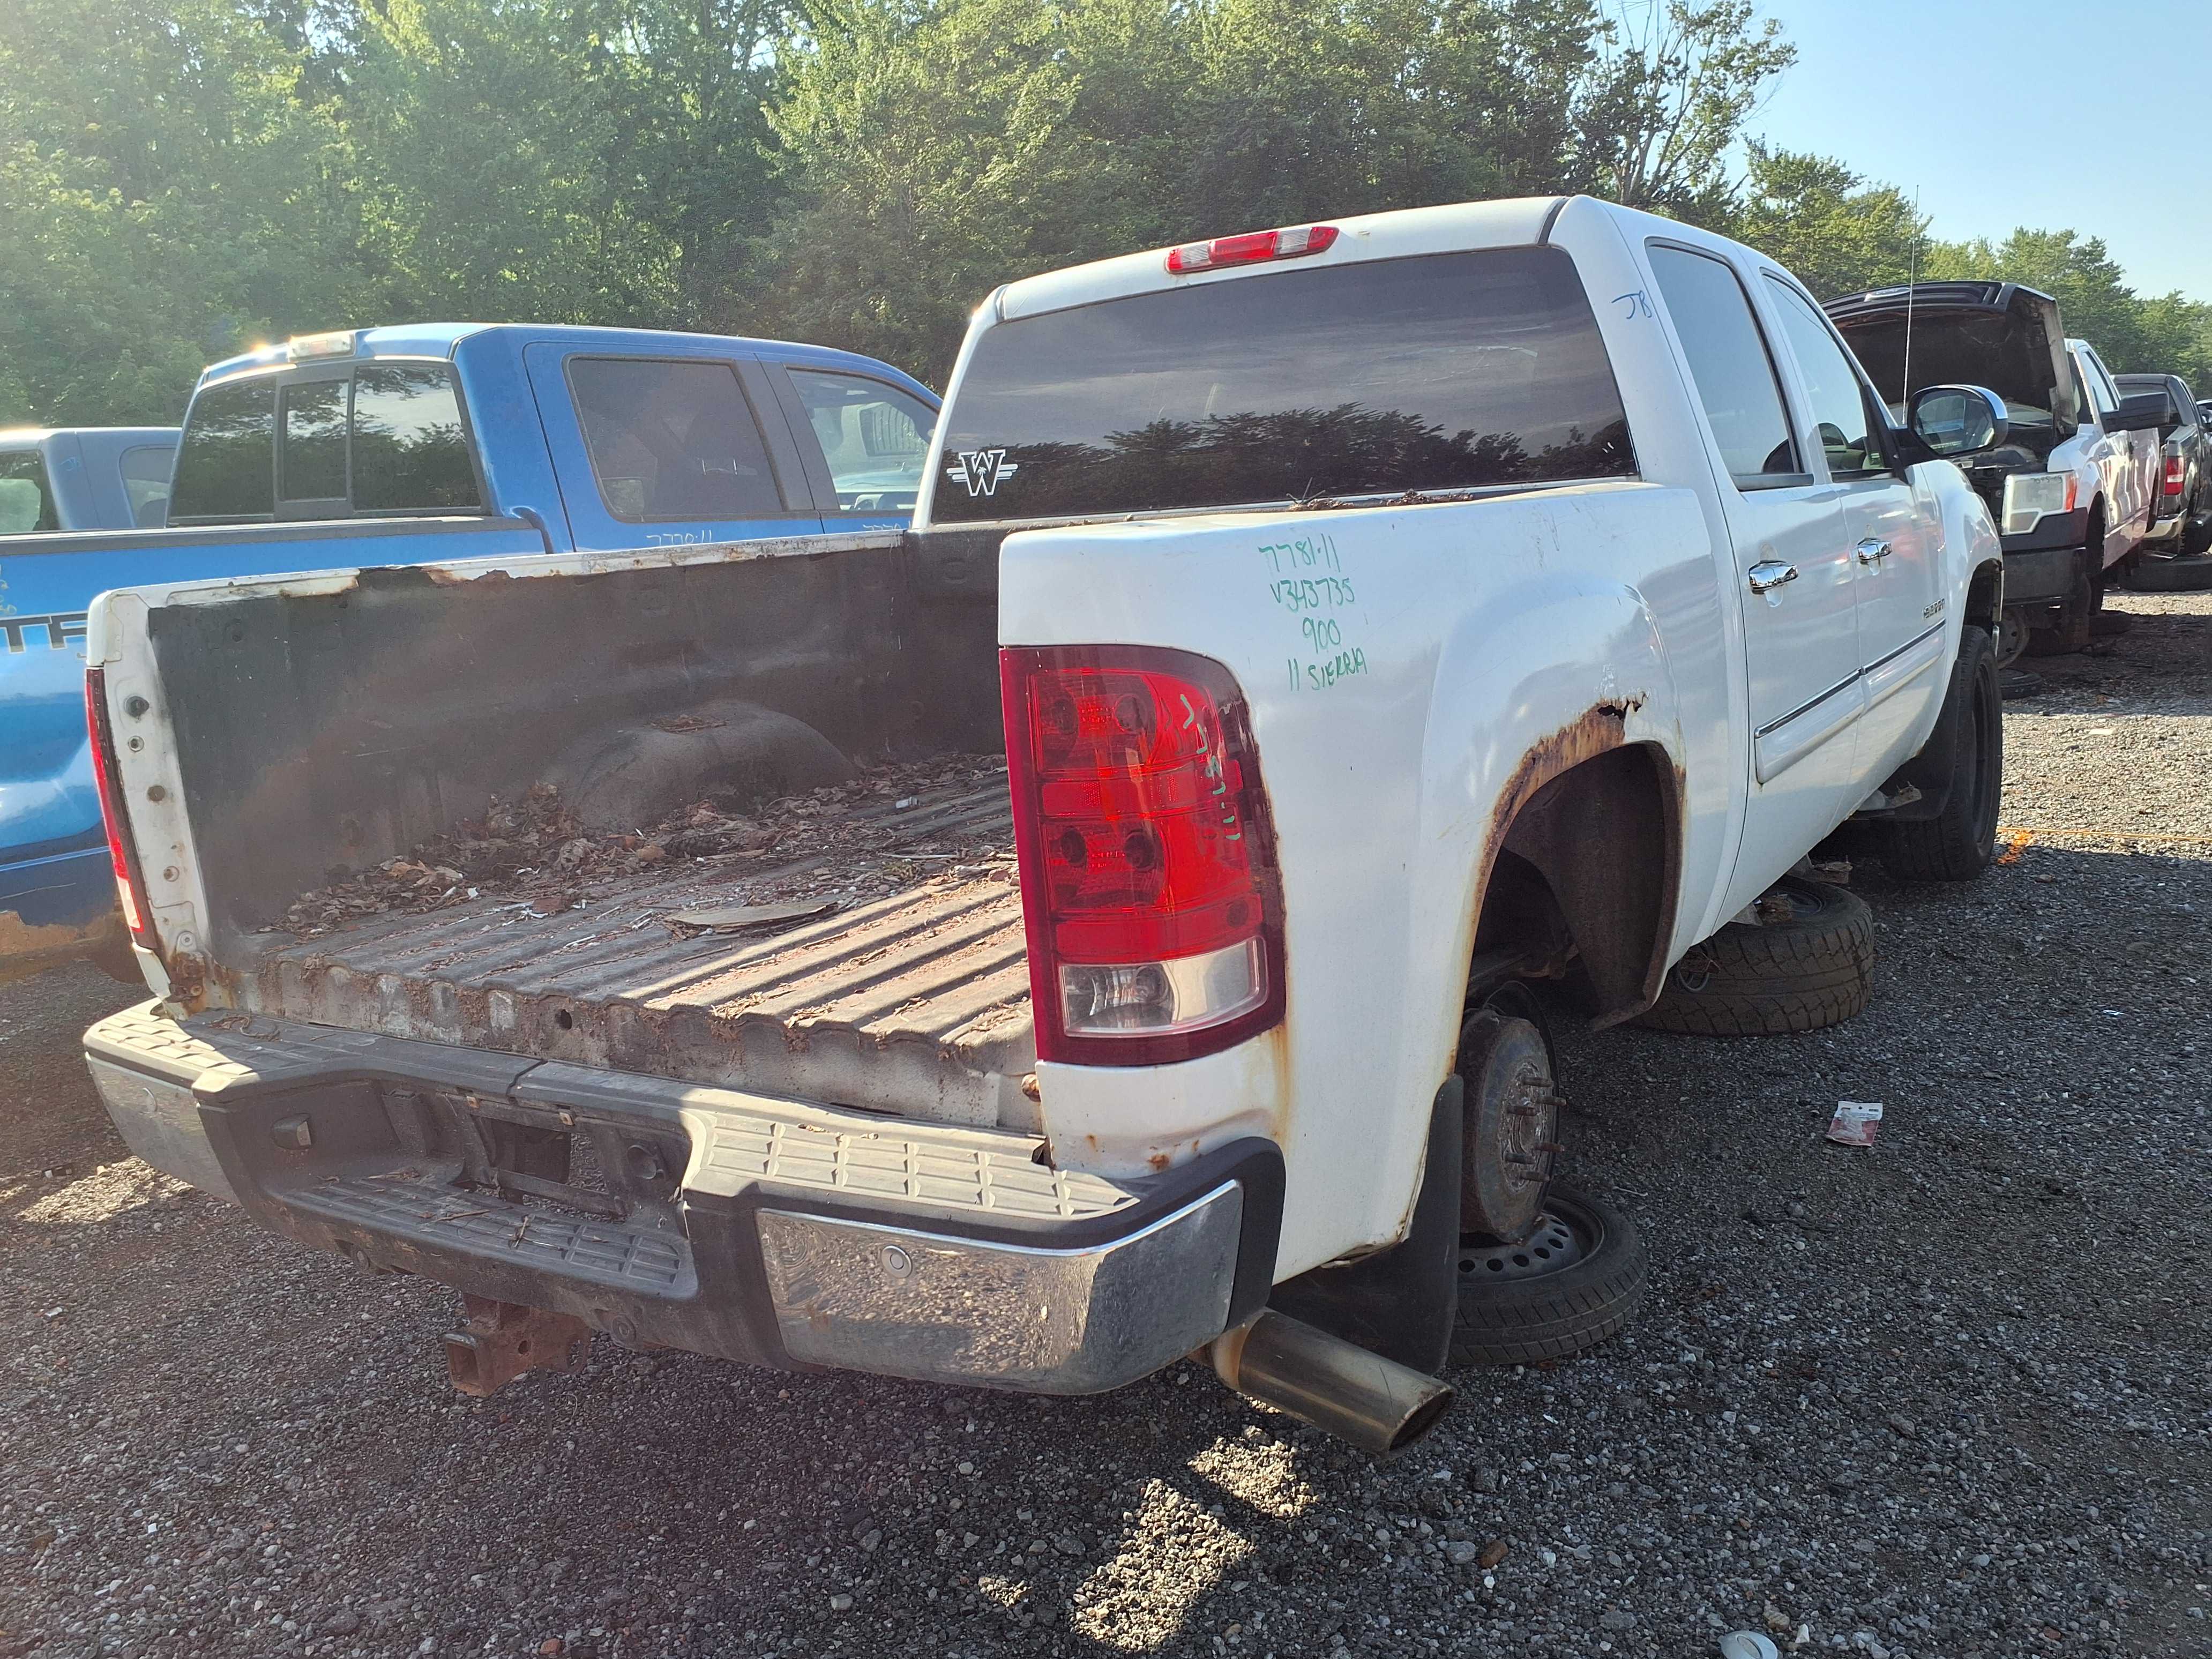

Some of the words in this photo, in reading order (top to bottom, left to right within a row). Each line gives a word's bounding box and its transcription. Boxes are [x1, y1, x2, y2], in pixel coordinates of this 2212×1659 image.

[1302, 617, 1341, 654] 900
[1288, 657, 1300, 692] 11
[1307, 647, 1367, 691] SIERRA
